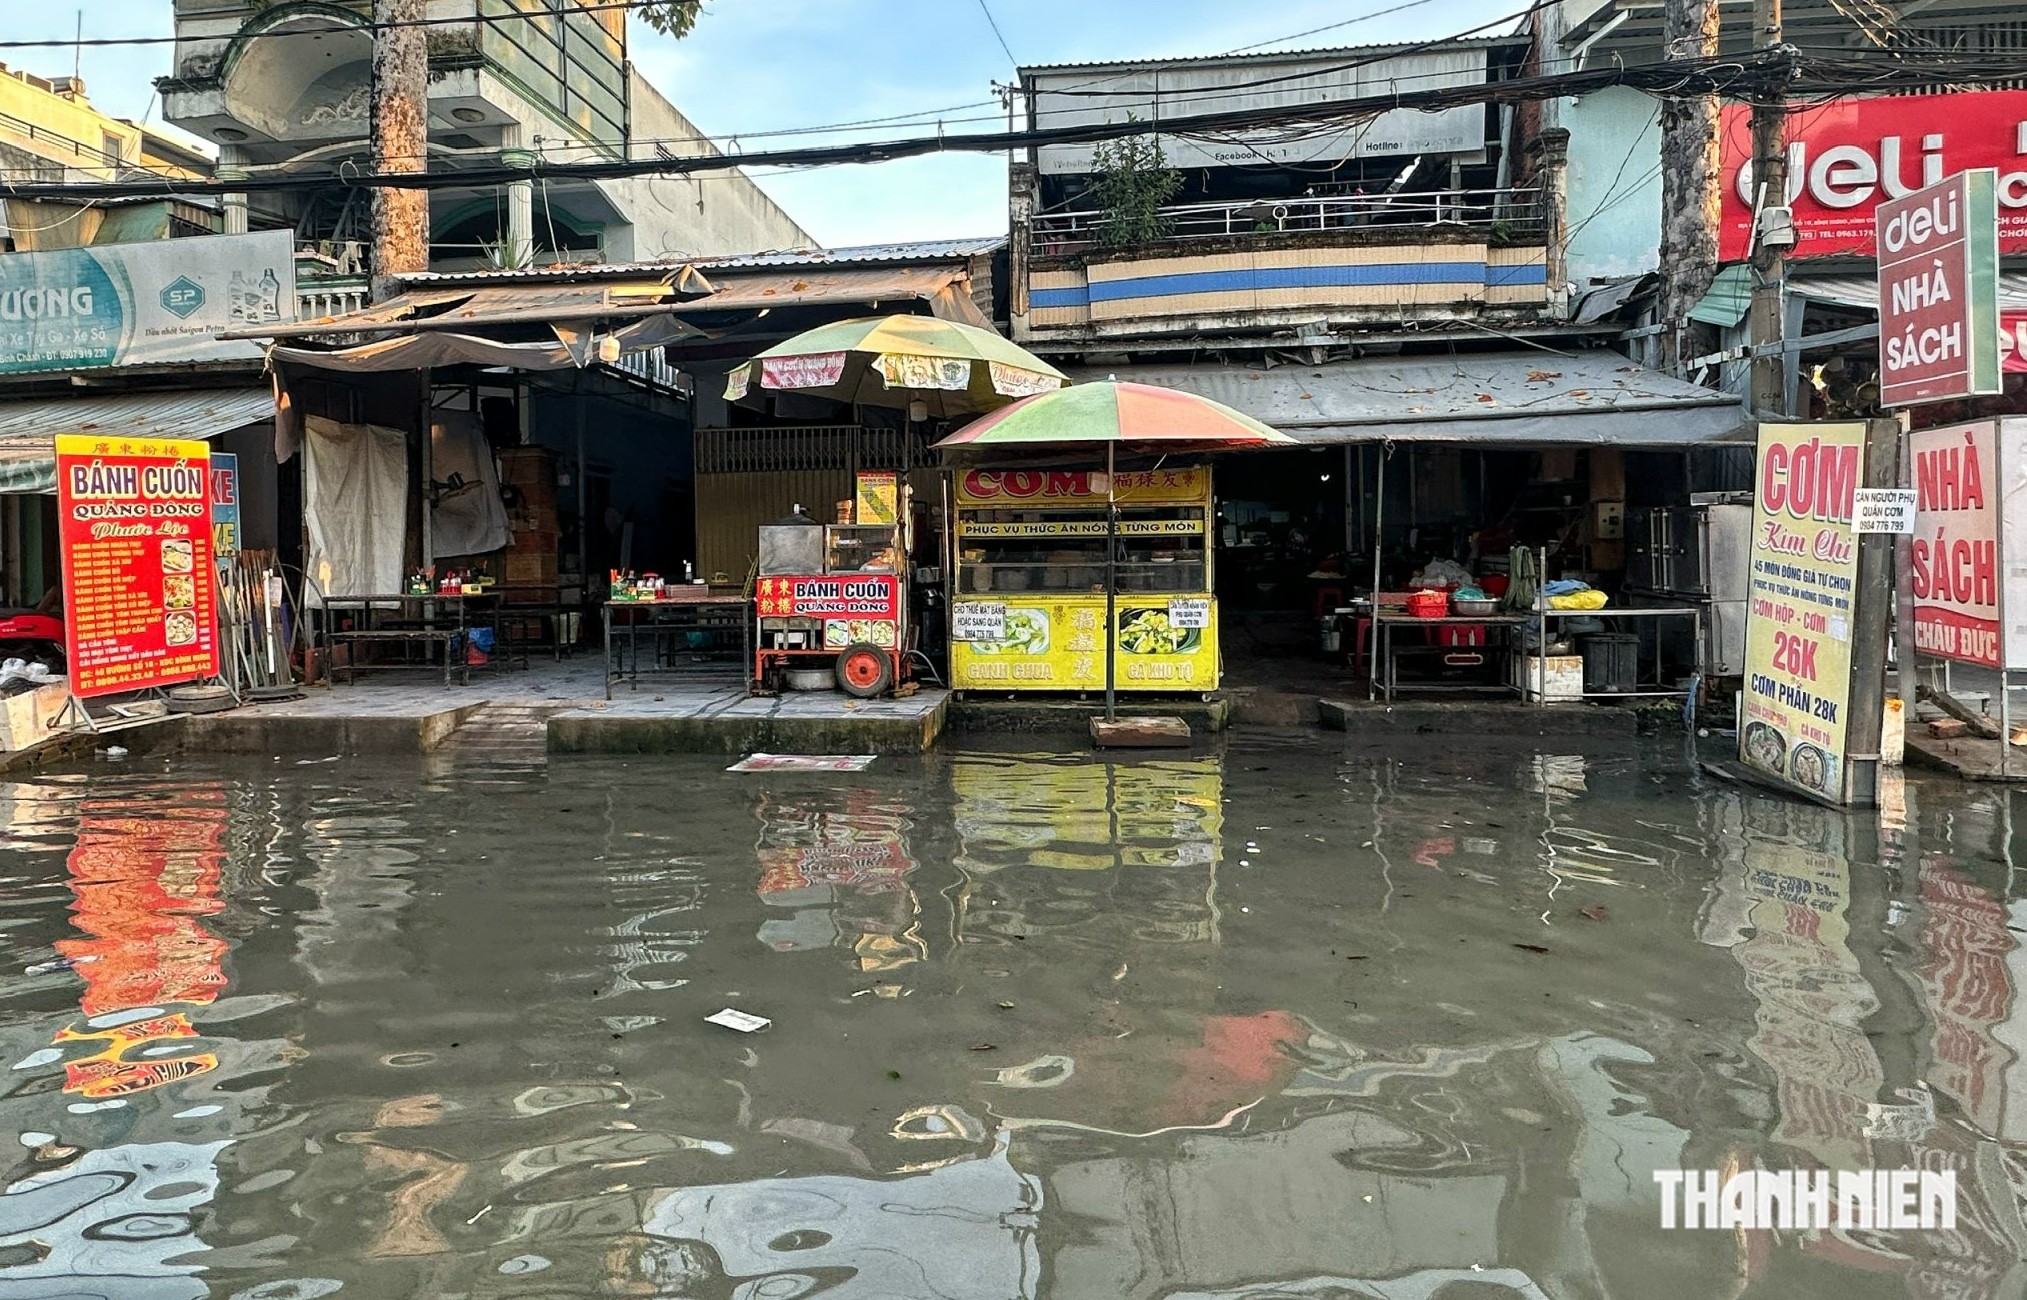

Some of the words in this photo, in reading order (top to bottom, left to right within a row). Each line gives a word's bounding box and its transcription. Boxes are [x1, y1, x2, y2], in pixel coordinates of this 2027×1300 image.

[1884, 189, 1957, 253] deli
[1891, 258, 1951, 317] NHÀ
[1886, 322, 1962, 372] SÁCH
[72, 460, 138, 498] BÁNH
[144, 459, 203, 498] CUỐN
[1762, 437, 1859, 521] CƠM
[1917, 431, 1984, 512] NHÀ
[75, 501, 147, 517] QUẢNG
[152, 502, 203, 516] ĐÔNG
[1862, 504, 1883, 517] QUÁN
[1898, 492, 1916, 506] PHỤ
[91, 521, 152, 539] Phước
[156, 522, 188, 536] Lộc
[965, 525, 999, 537] PHỤC
[1003, 524, 1020, 535] VỤ
[1024, 521, 1056, 533] THỨC
[1125, 519, 1160, 532] TỪNG
[1164, 519, 1196, 531] MÓN
[1757, 520, 1805, 556] Kim
[1813, 529, 1853, 563] Chi
[1829, 575, 1852, 594] CHỌN
[1912, 527, 1996, 607] SÁCH
[795, 579, 839, 599] BÁNH
[843, 577, 890, 600] CUỐN
[795, 599, 846, 614] QUẢNG
[848, 600, 890, 612] ĐÔNG
[1753, 598, 1773, 619] CƠM
[1775, 602, 1795, 627] HỘP
[1803, 611, 1826, 634] CƠM
[1772, 630, 1818, 682] 26K
[1915, 618, 1956, 653] CHÂU
[1960, 623, 1998, 661] ĐỨC
[967, 662, 1009, 681] CANH
[1012, 662, 1053, 681] CHUA
[1148, 662, 1174, 680] KHO
[1751, 672, 1776, 700] CƠM
[1813, 696, 1838, 724] 28K
